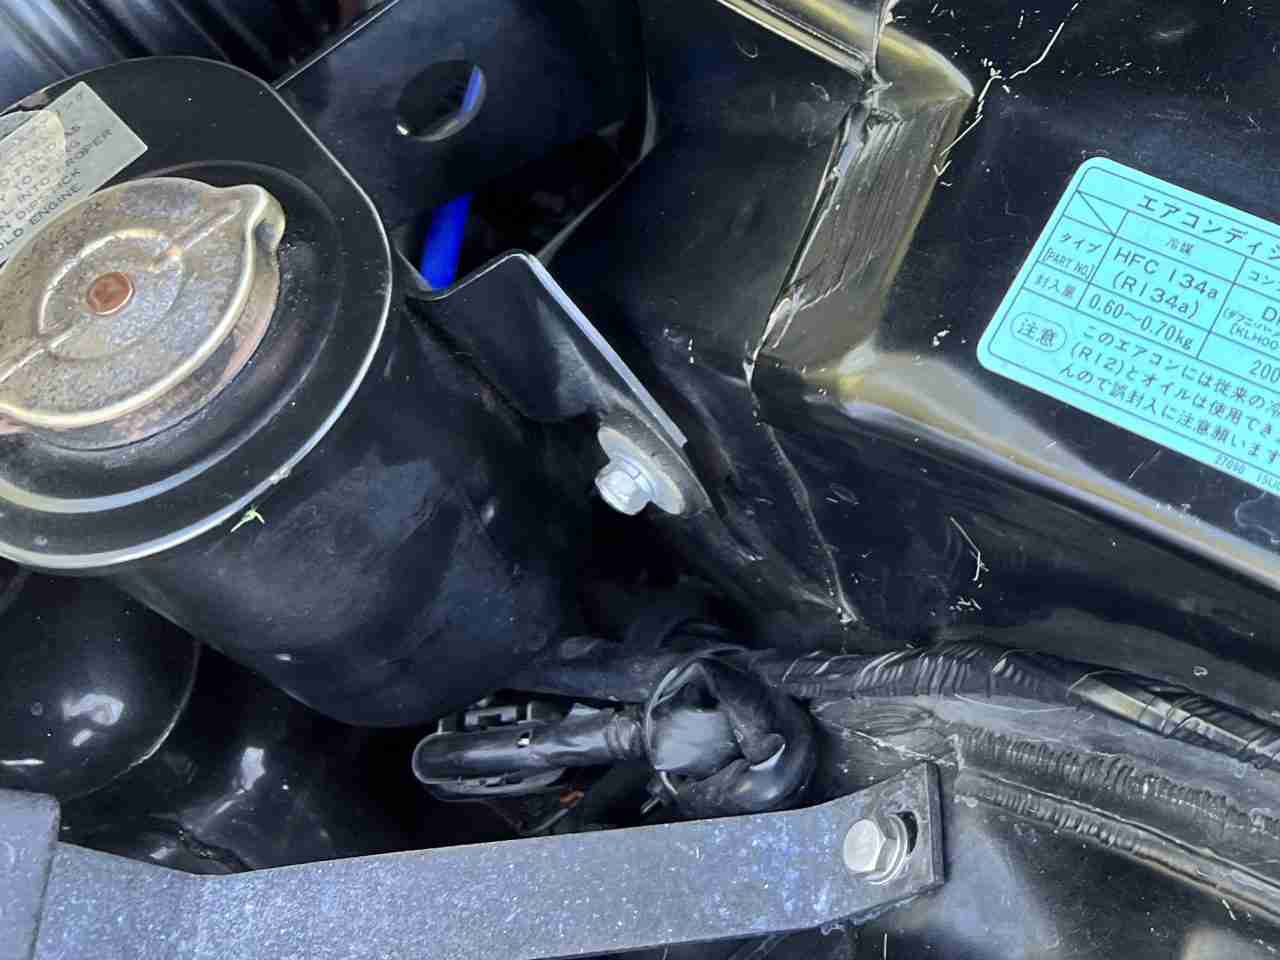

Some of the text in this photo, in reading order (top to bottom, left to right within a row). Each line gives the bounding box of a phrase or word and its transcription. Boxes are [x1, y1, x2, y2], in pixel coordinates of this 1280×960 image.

[1108, 267, 1203, 321] (R134a)
[1112, 246, 1222, 300] HFC 134a
[1014, 317, 1060, 350] 注意
